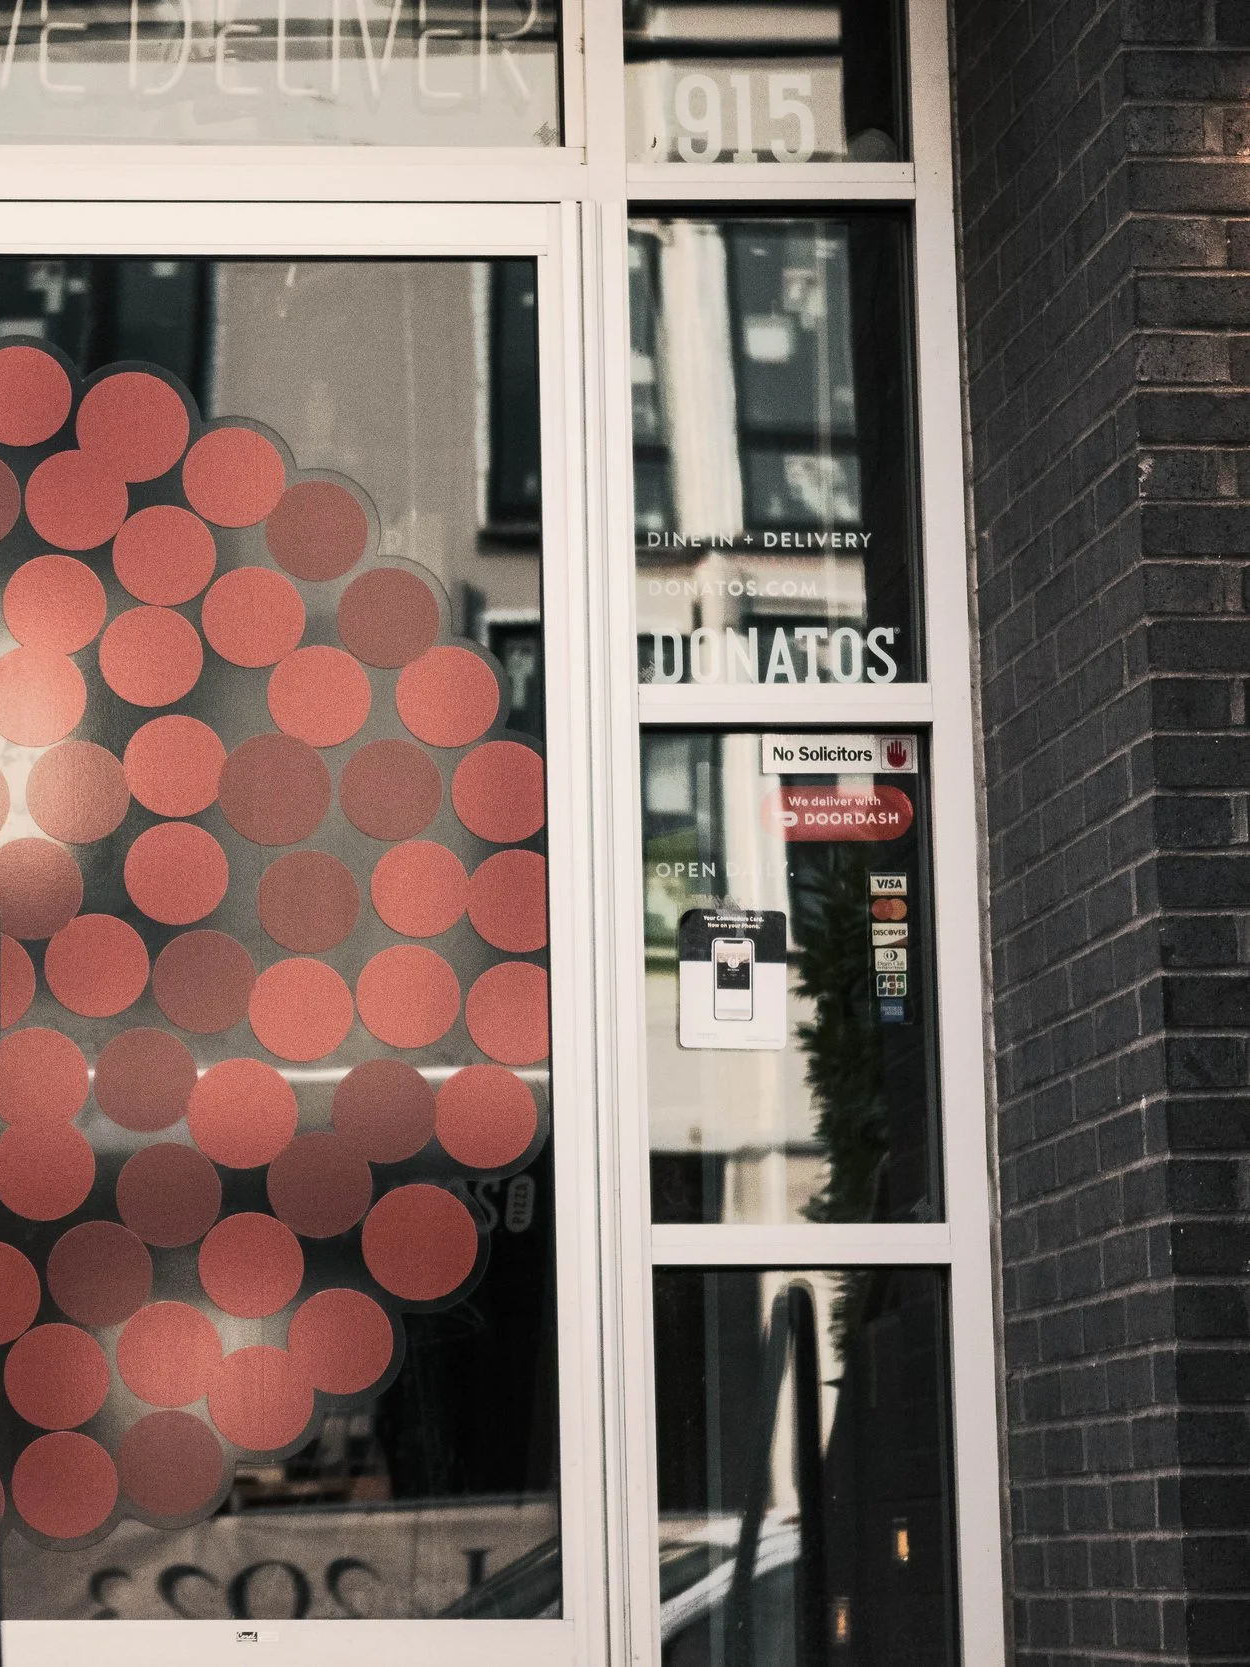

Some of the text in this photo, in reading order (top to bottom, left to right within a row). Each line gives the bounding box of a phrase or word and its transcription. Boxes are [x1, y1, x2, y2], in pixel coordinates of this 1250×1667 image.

[129, 0, 532, 100] DELIVER
[640, 73, 816, 163] 1915
[647, 532, 702, 547] DINE
[711, 532, 734, 547] IN
[764, 532, 872, 548] DELIVERY
[649, 580, 818, 597] DONATOS.COM
[773, 746, 872, 761] No Solicitors
[788, 796, 881, 807] We deliver with
[804, 812, 899, 825] DOORDASH
[656, 863, 716, 878] OPEN
[876, 879, 903, 889] VISA
[873, 929, 907, 937] DISCOVER
[878, 981, 905, 989] JCB
